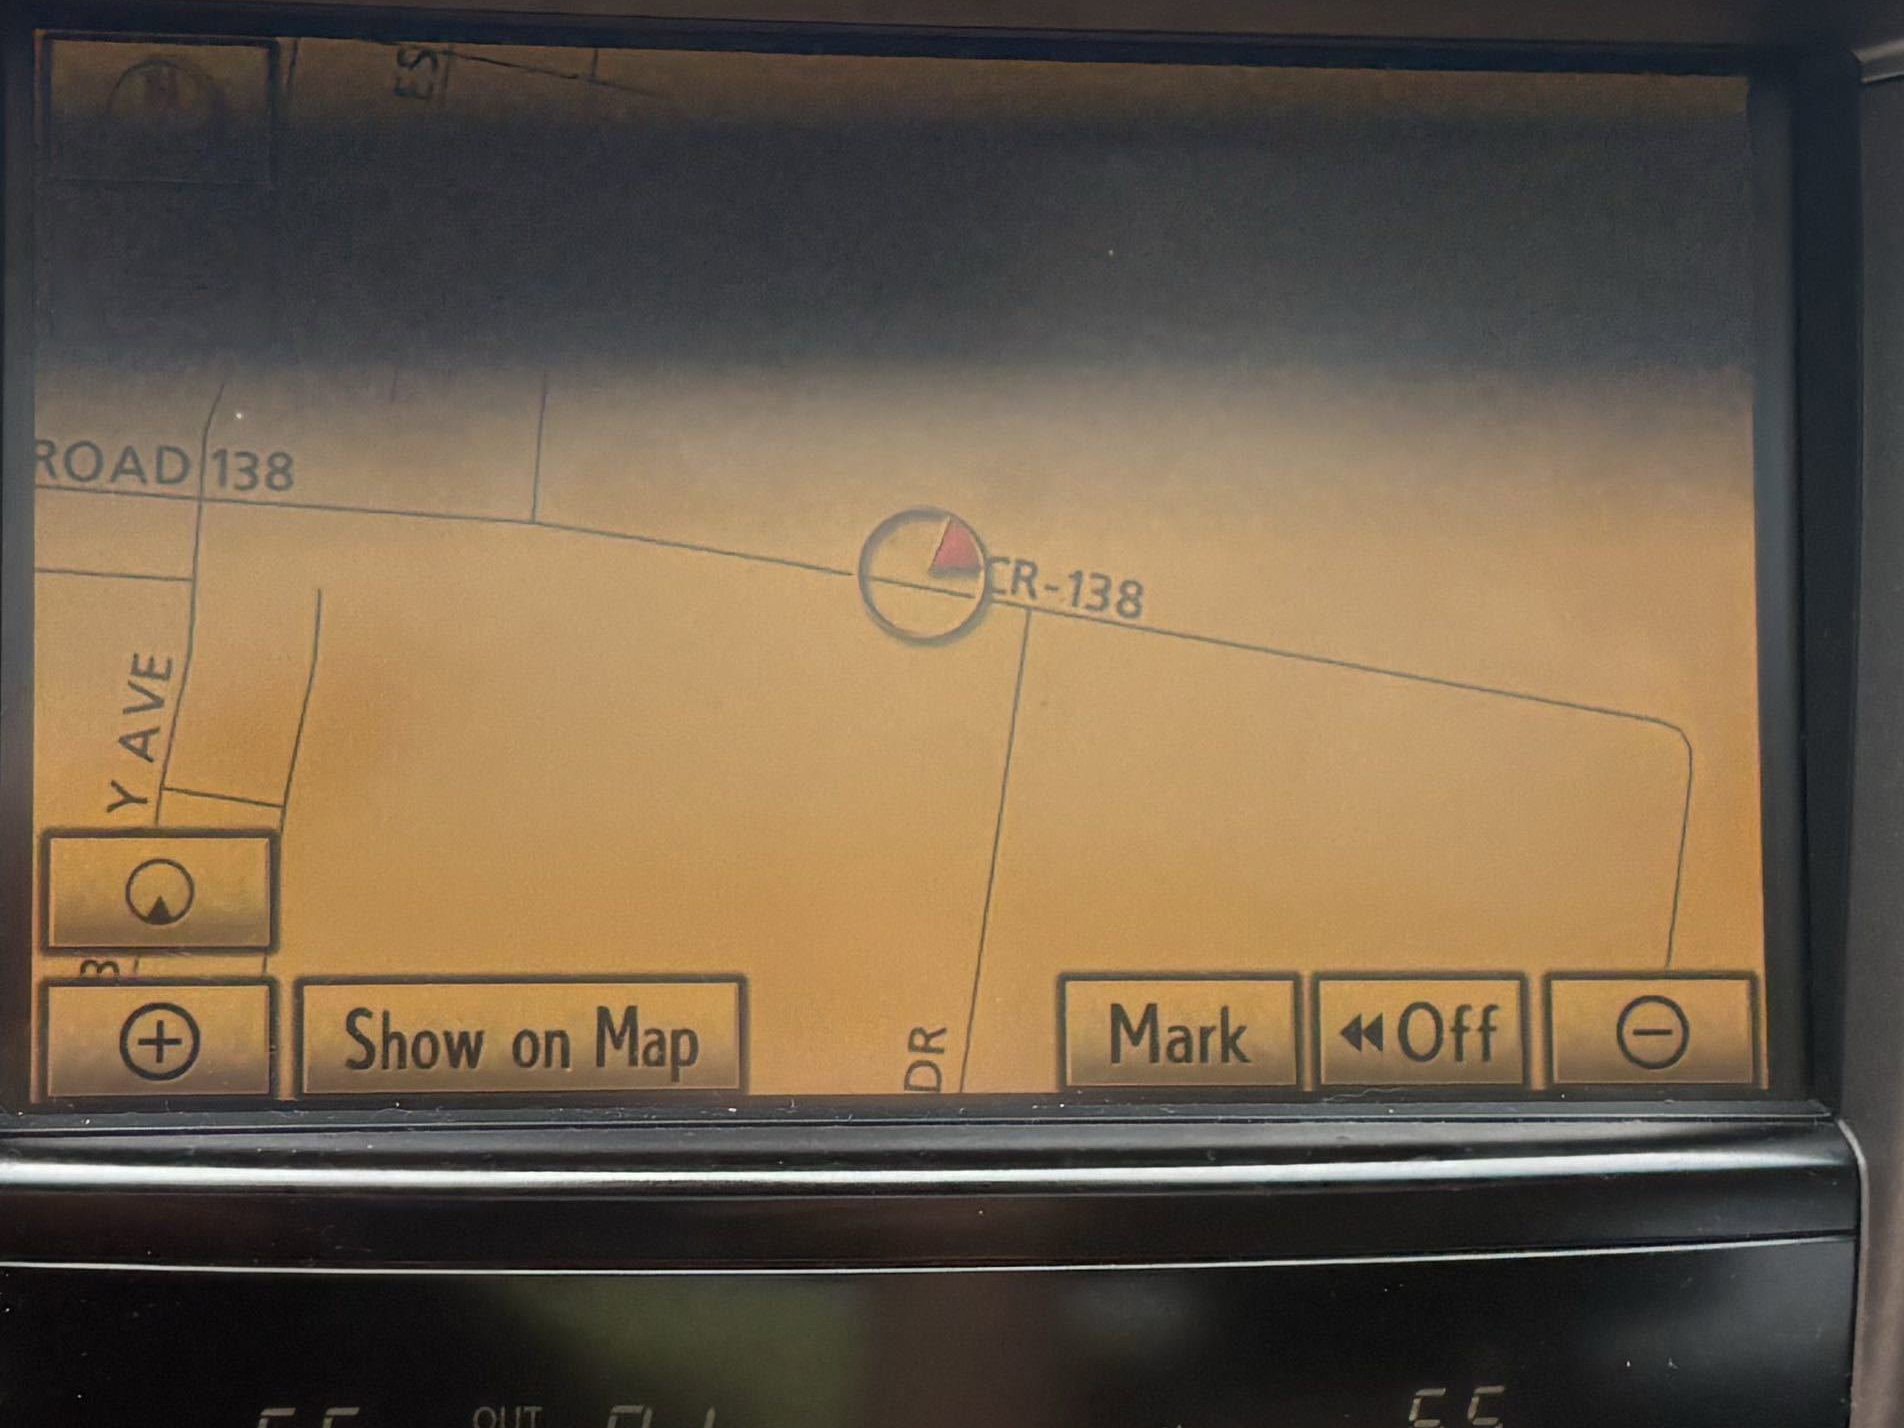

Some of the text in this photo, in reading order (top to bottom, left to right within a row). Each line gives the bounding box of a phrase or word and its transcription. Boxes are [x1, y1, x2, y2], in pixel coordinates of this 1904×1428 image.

[211, 447, 295, 492] 138
[985, 553, 1145, 620] CR-138
[116, 651, 174, 763] AVE
[343, 1004, 699, 1083] Show on Map
[903, 1024, 947, 1093] DR
[1108, 1002, 1250, 1066] Mark
[1397, 999, 1500, 1063] Off
